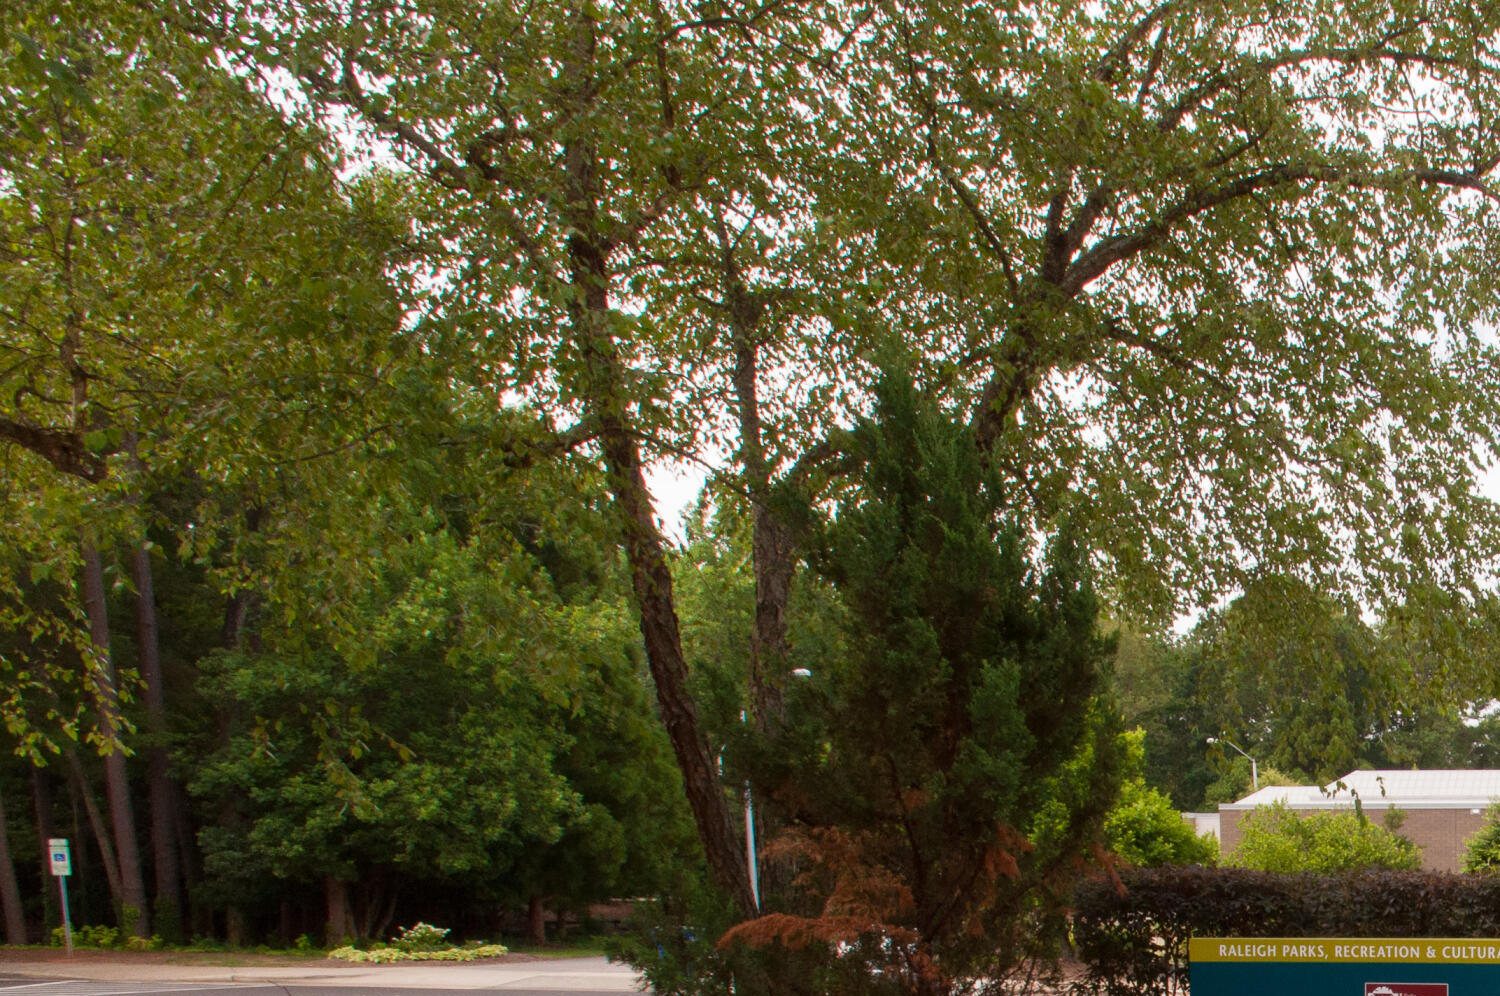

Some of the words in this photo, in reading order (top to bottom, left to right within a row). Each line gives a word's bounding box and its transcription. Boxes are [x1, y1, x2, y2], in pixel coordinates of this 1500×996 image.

[1219, 944, 1277, 958] RALEIGH
[1282, 945, 1329, 960] PARKS,
[1334, 945, 1420, 959] RECREATION
[1426, 946, 1436, 959] &
